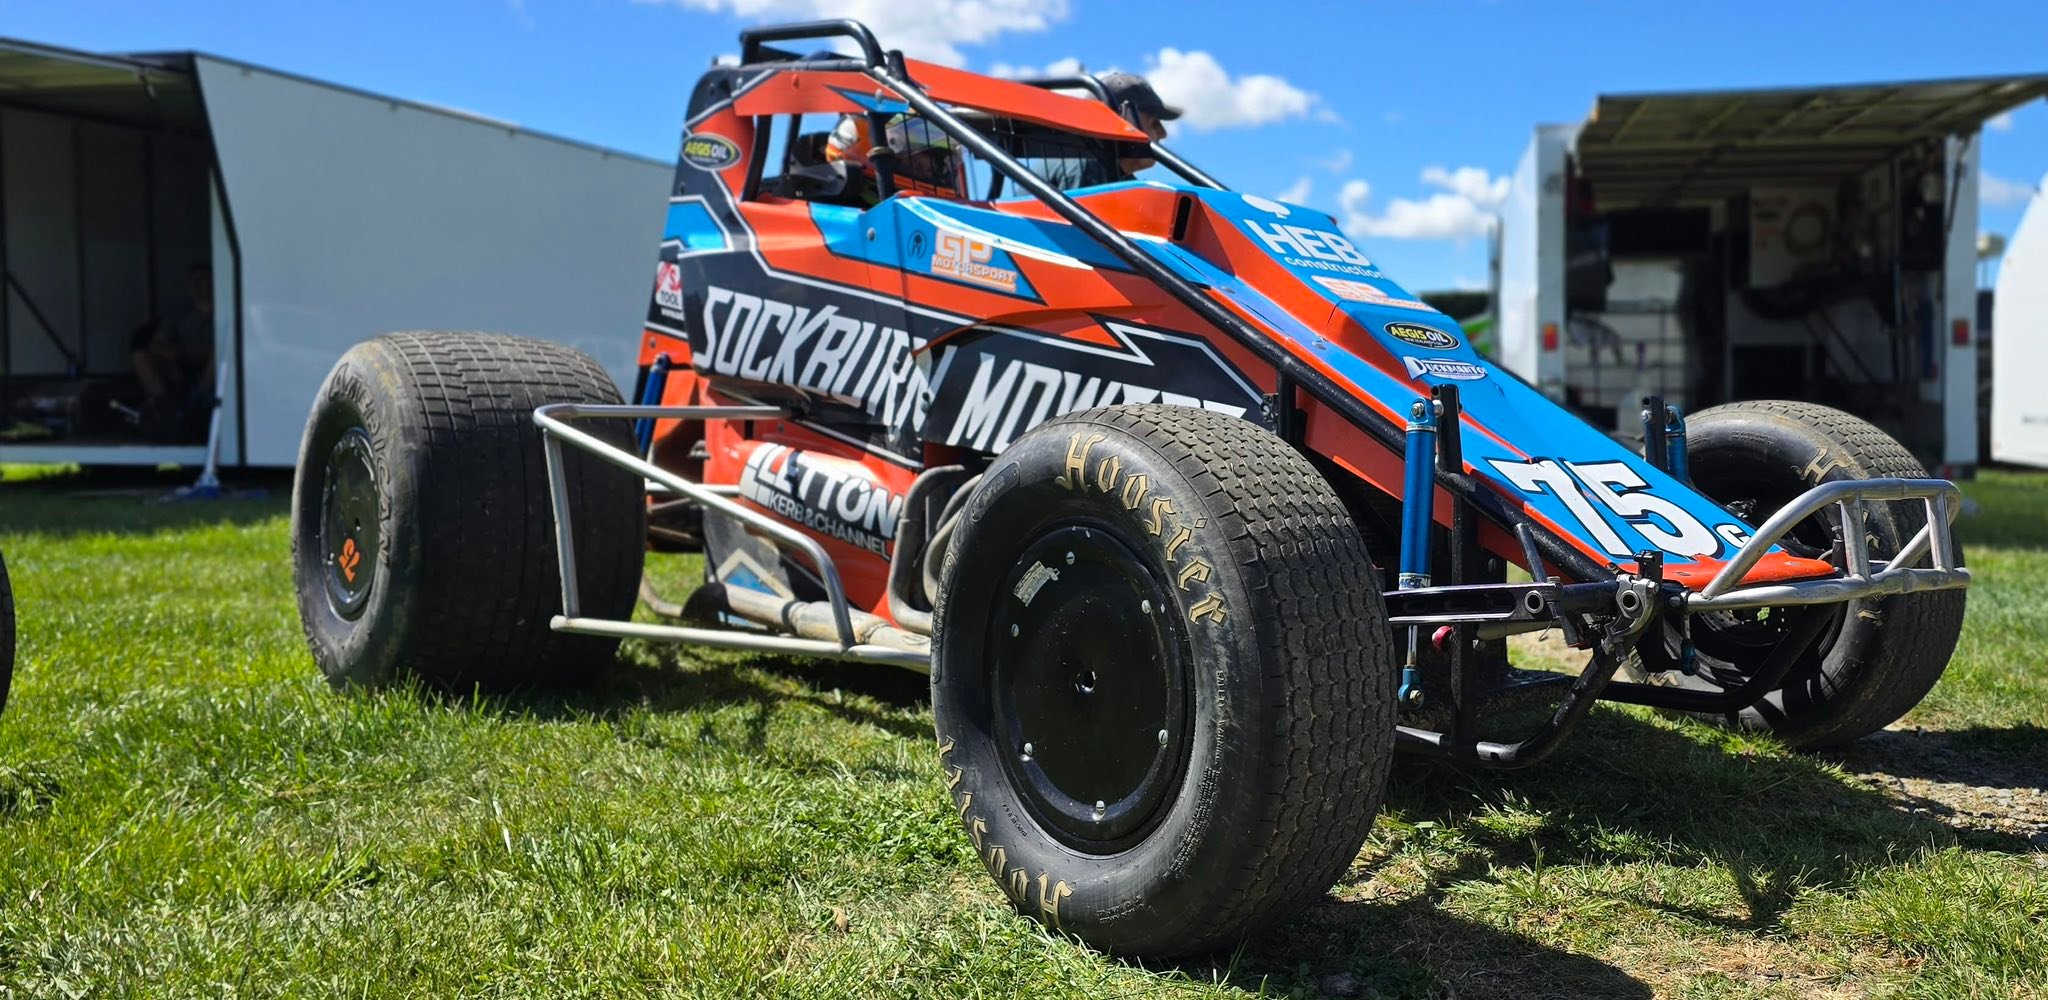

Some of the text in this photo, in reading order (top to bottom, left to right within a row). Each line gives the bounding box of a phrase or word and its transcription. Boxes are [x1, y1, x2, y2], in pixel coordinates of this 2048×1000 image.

[1243, 219, 1372, 267] HEB
[932, 254, 1018, 284] MOTORSPORT
[1284, 256, 1384, 279] construction
[692, 284, 957, 434] SOCKBURN
[1055, 431, 1227, 627] Hoosier
